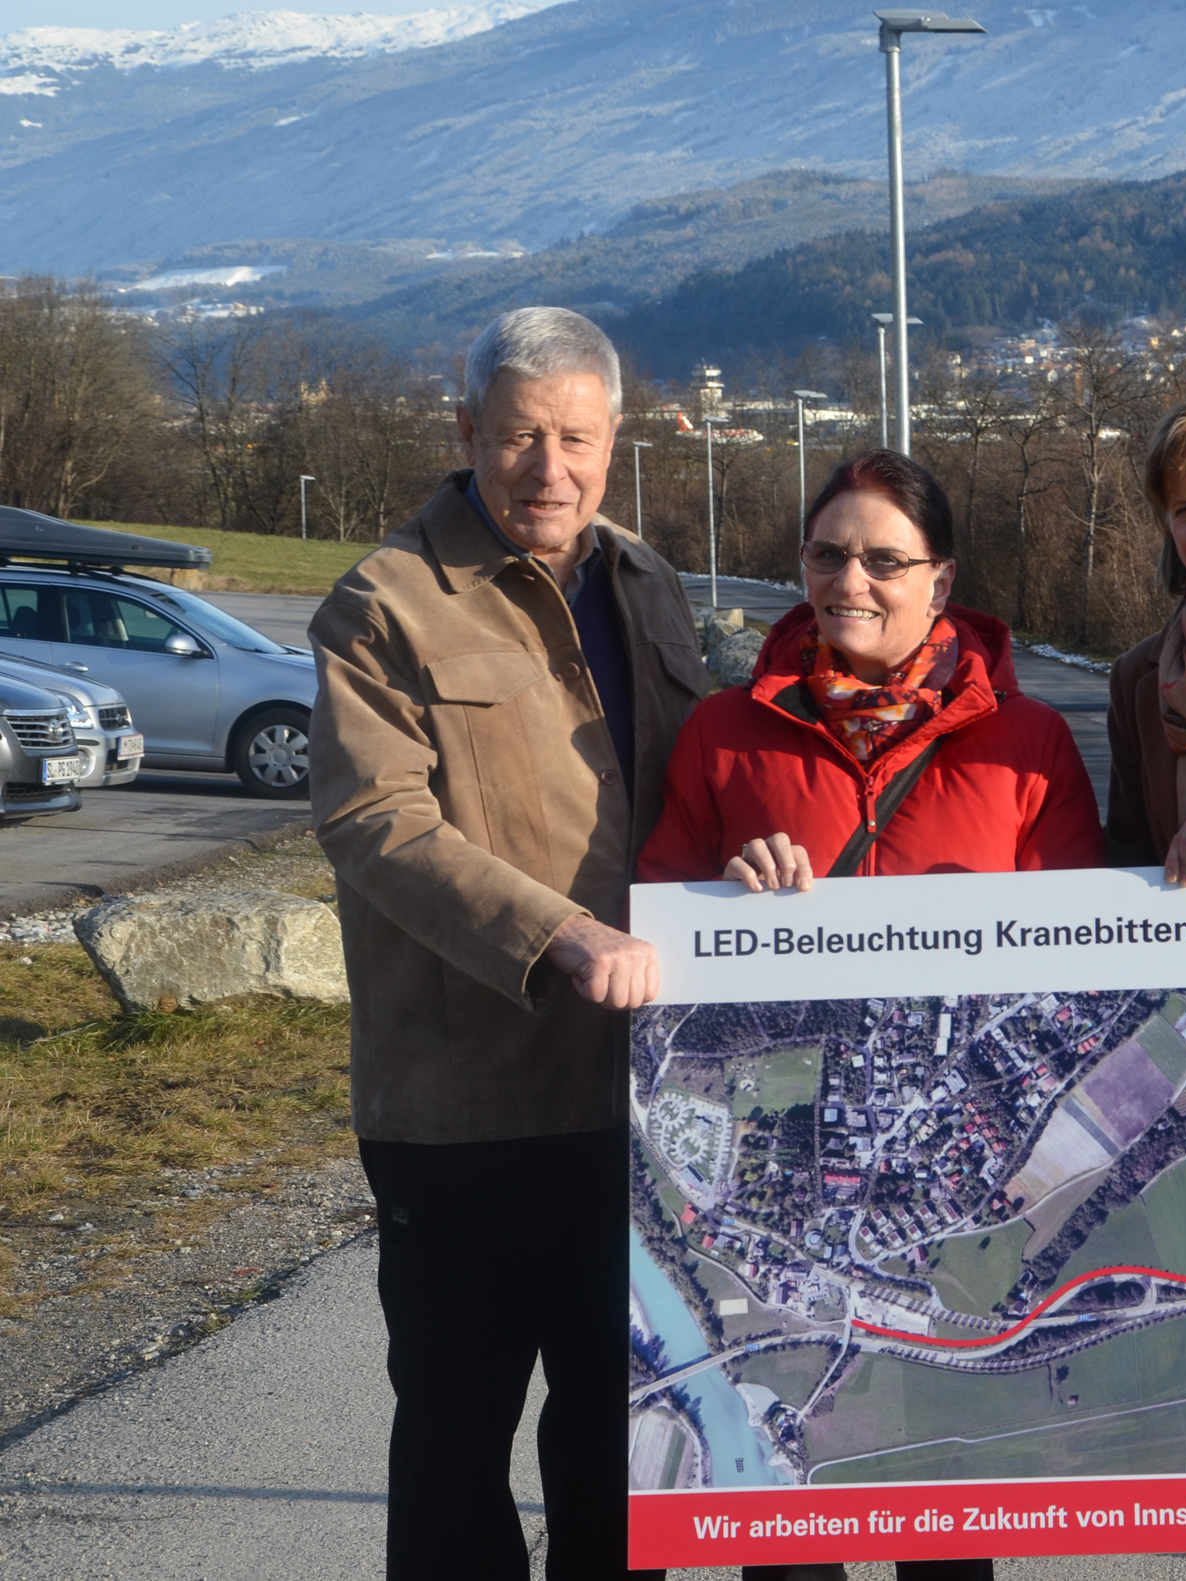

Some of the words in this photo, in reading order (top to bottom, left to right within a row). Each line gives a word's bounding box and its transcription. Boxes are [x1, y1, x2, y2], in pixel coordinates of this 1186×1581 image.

[694, 924, 983, 958] LED-Beleuchtung
[694, 1514, 741, 1540] Wir
[749, 1511, 859, 1537] arbeiten
[867, 1510, 906, 1534] für
[914, 1508, 955, 1533] die
[962, 1504, 1068, 1531] Zukunft
[1075, 1508, 1125, 1528] von
